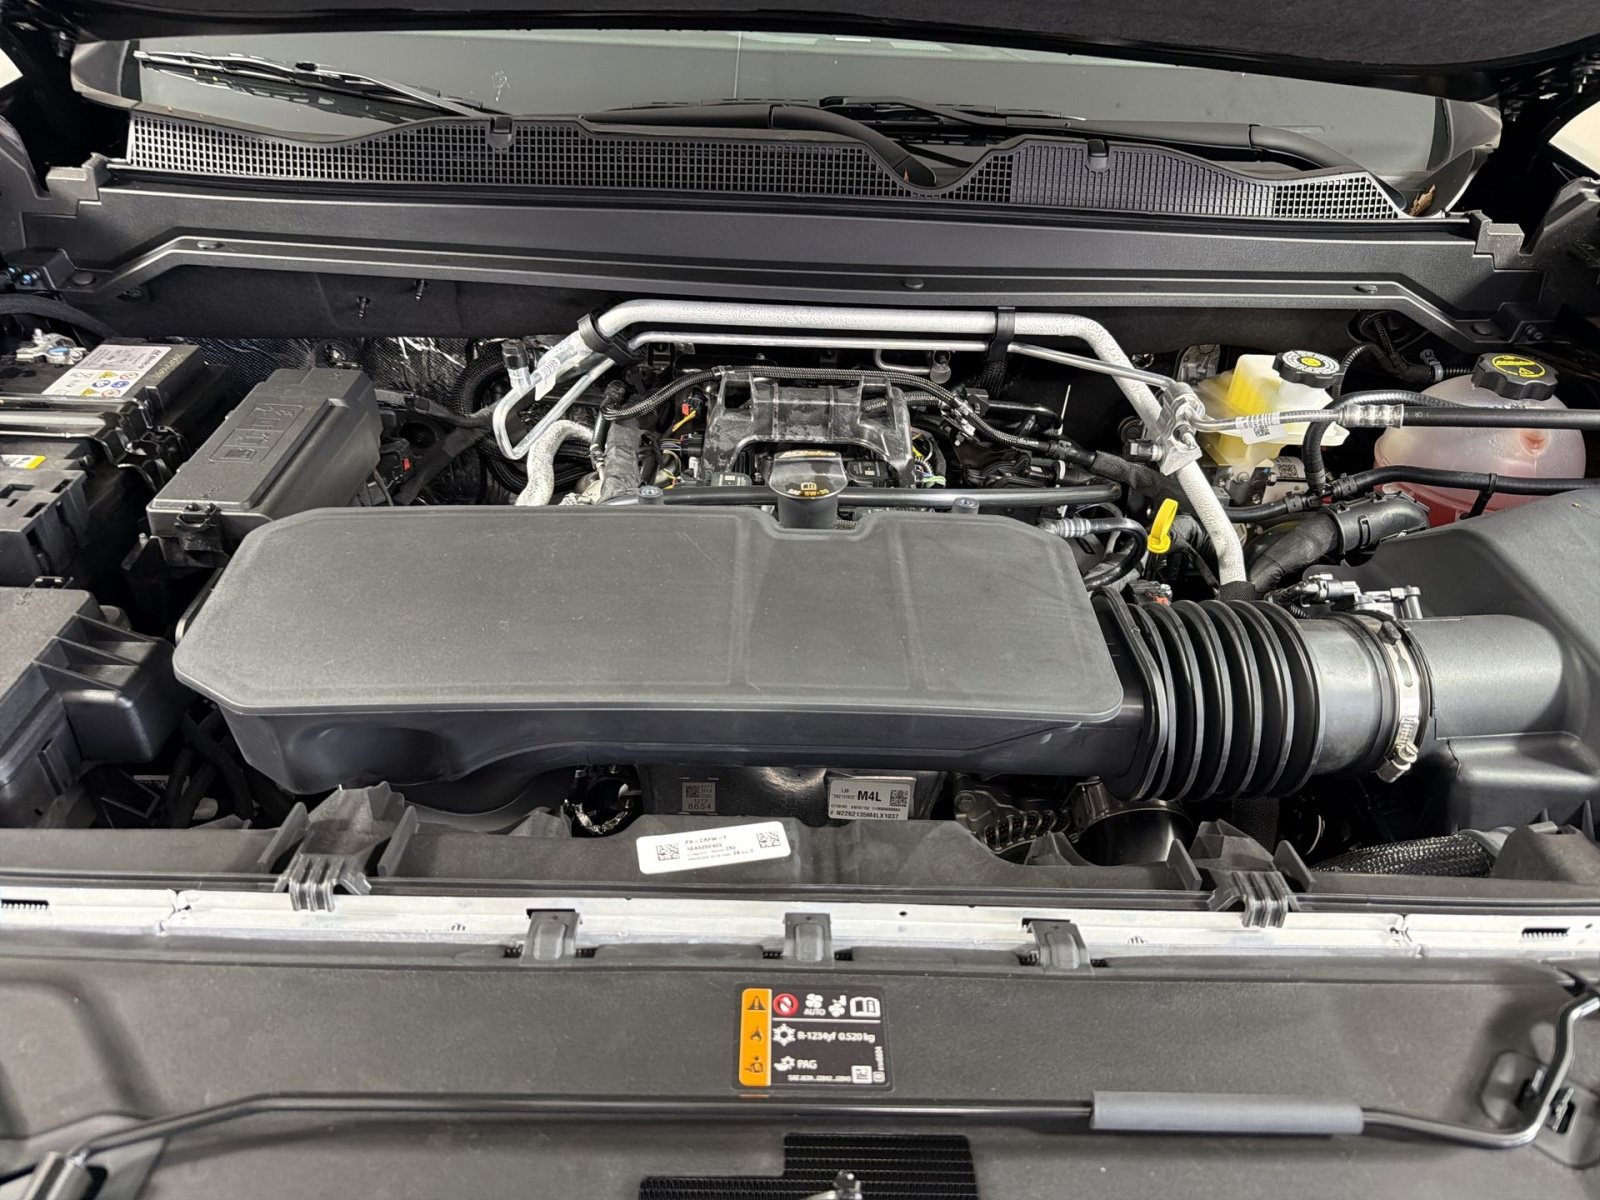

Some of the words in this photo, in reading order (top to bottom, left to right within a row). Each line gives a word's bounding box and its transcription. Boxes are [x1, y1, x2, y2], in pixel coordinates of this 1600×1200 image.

[857, 790, 882, 802] M4L
[803, 1008, 826, 1016] AUTO
[797, 1031, 837, 1043] R-1234yf
[838, 1032, 863, 1042] 0.520
[863, 1032, 876, 1043] kg
[796, 1060, 818, 1070] PAG
